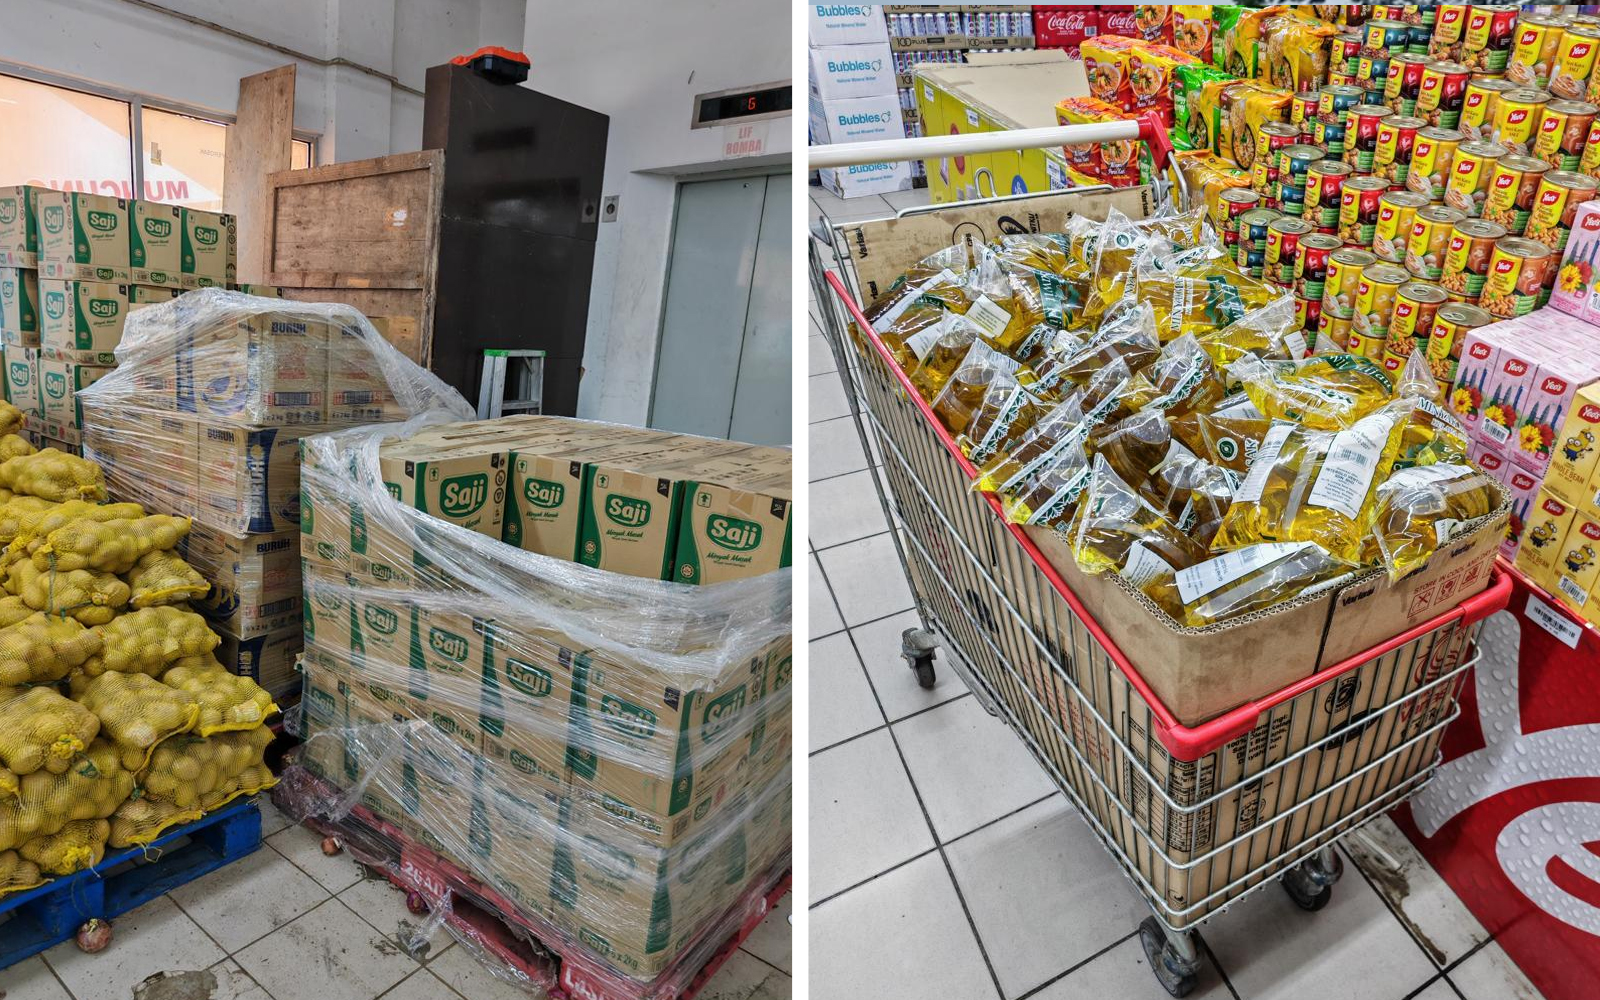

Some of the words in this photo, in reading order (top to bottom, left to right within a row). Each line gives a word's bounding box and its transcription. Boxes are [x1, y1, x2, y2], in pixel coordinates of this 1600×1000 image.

[817, 5, 861, 18] Bubbles
[828, 59, 871, 73] Bubbles
[839, 112, 881, 126] Bubbles
[738, 126, 753, 139] LIF
[726, 139, 762, 155] BOMBA
[848, 161, 889, 175] Bubbles
[44, 207, 64, 232] Saji
[90, 212, 116, 231] Saji
[146, 219, 170, 236] Saji
[195, 228, 218, 245] Saji
[98, 269, 113, 279] Saji
[151, 272, 166, 284] Saji
[46, 292, 64, 317] Saji
[92, 301, 117, 317] Saji
[271, 322, 306, 335] BURUH
[1473, 344, 1489, 357] Yeo's
[12, 364, 29, 384] Saji
[1507, 361, 1525, 374] Yeo's
[46, 375, 65, 396] Saji
[1545, 379, 1564, 393] Yeo's
[1582, 406, 1600, 420] Yeo's
[207, 428, 235, 442] BURUH
[1551, 460, 1571, 476] WHOLE
[1569, 469, 1585, 484] BEAN
[1515, 475, 1531, 487] Yeo's
[444, 478, 485, 512] Saji
[527, 481, 562, 507] Saji
[608, 498, 647, 526] Saji
[1547, 501, 1562, 513] Yeo's
[711, 518, 758, 548] Saji
[256, 538, 291, 553] BURUH
[707, 551, 731, 563] Minyak
[731, 553, 754, 563] Masak
[372, 564, 391, 581] Saji
[1413, 580, 1436, 595] STORE
[1447, 566, 1464, 580] COOL
[366, 606, 397, 634] Saji
[431, 630, 466, 661] Saji
[509, 662, 549, 695] Saji
[603, 699, 652, 736] Saji
[705, 689, 744, 734] Saji
[434, 712, 456, 732] Saji
[510, 752, 537, 774] Saji
